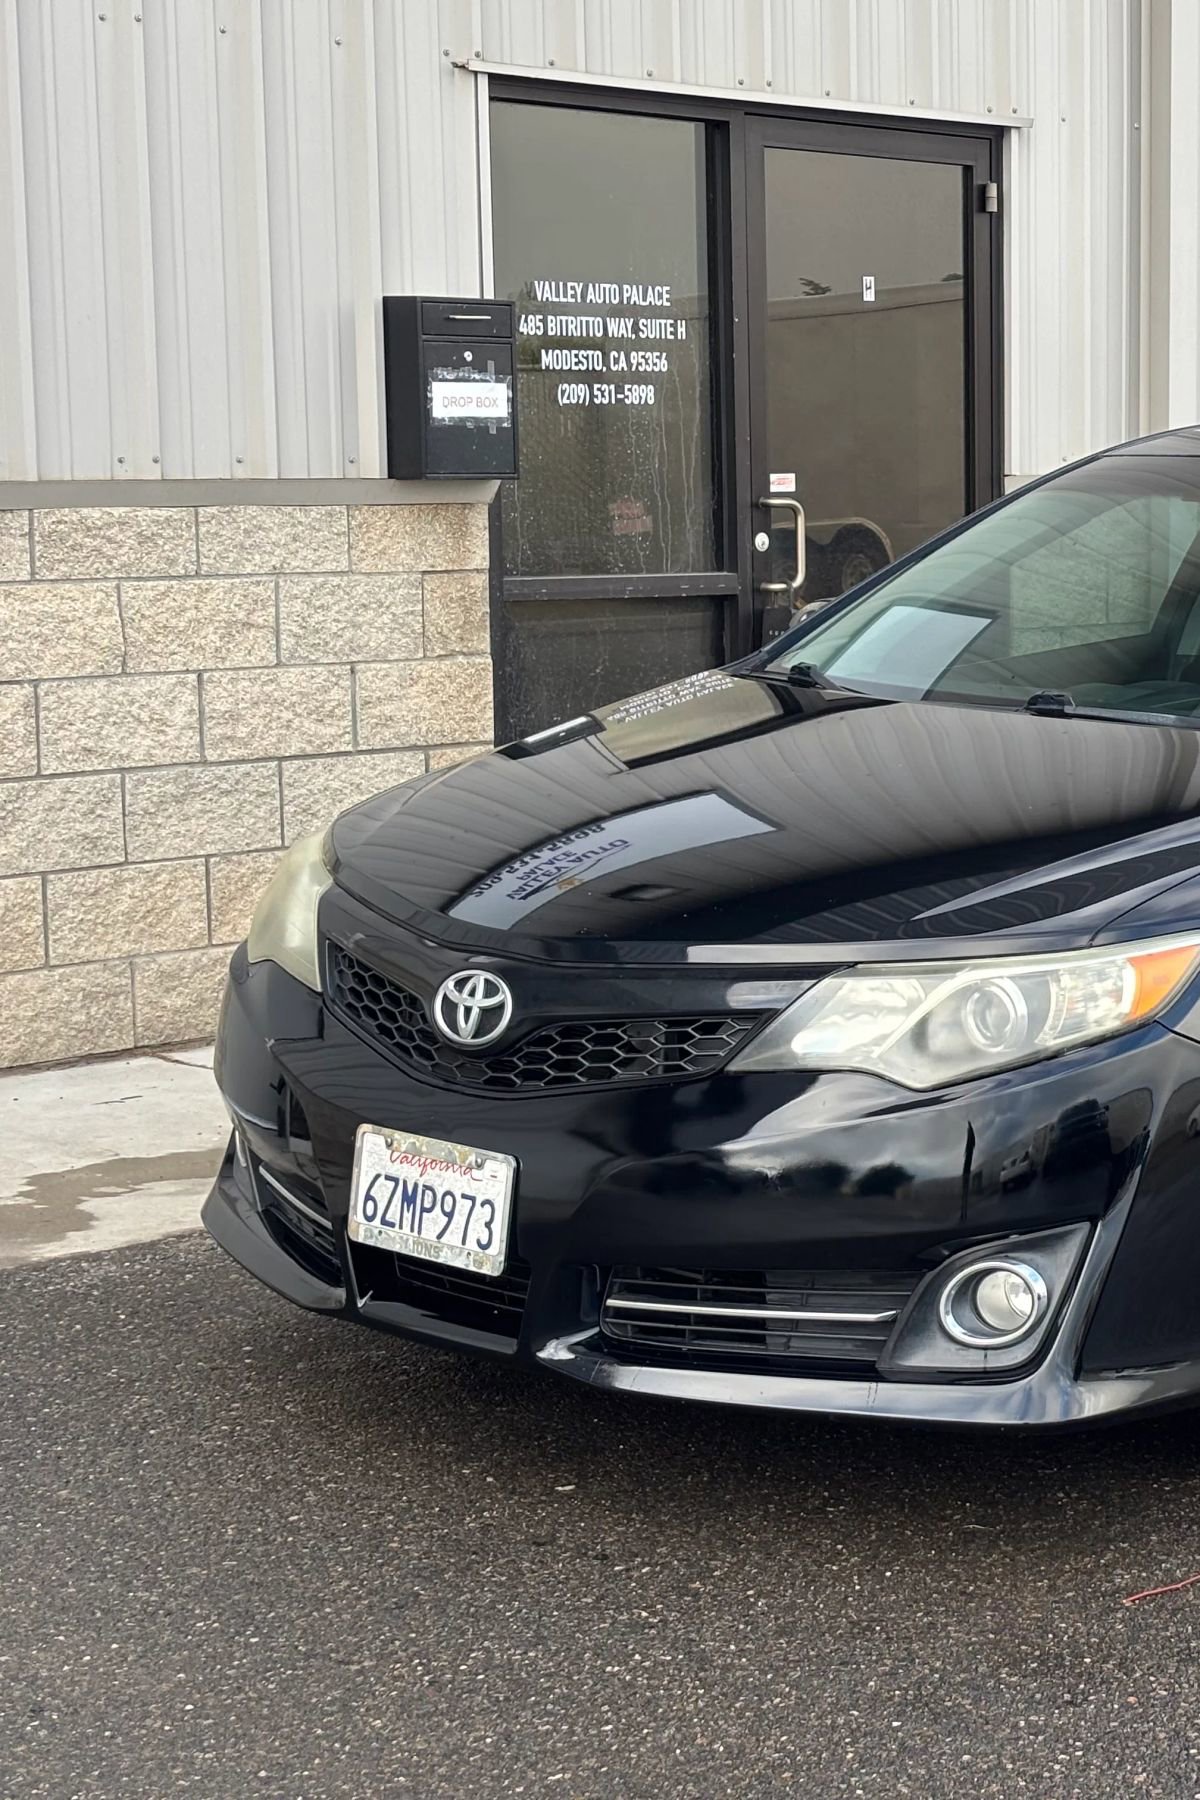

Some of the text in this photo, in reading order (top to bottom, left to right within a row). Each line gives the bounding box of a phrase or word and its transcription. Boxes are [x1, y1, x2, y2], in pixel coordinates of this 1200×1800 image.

[534, 280, 671, 306] VALLEY AUTO PALACE
[519, 314, 686, 340] 485 BITRITTO WAY, SUITE H
[541, 349, 668, 373] MODESTO, CA 95356
[442, 396, 499, 409] DROP BOX
[557, 383, 655, 406] (209) 531-5898
[362, 1173, 496, 1251] 6ZMP973
